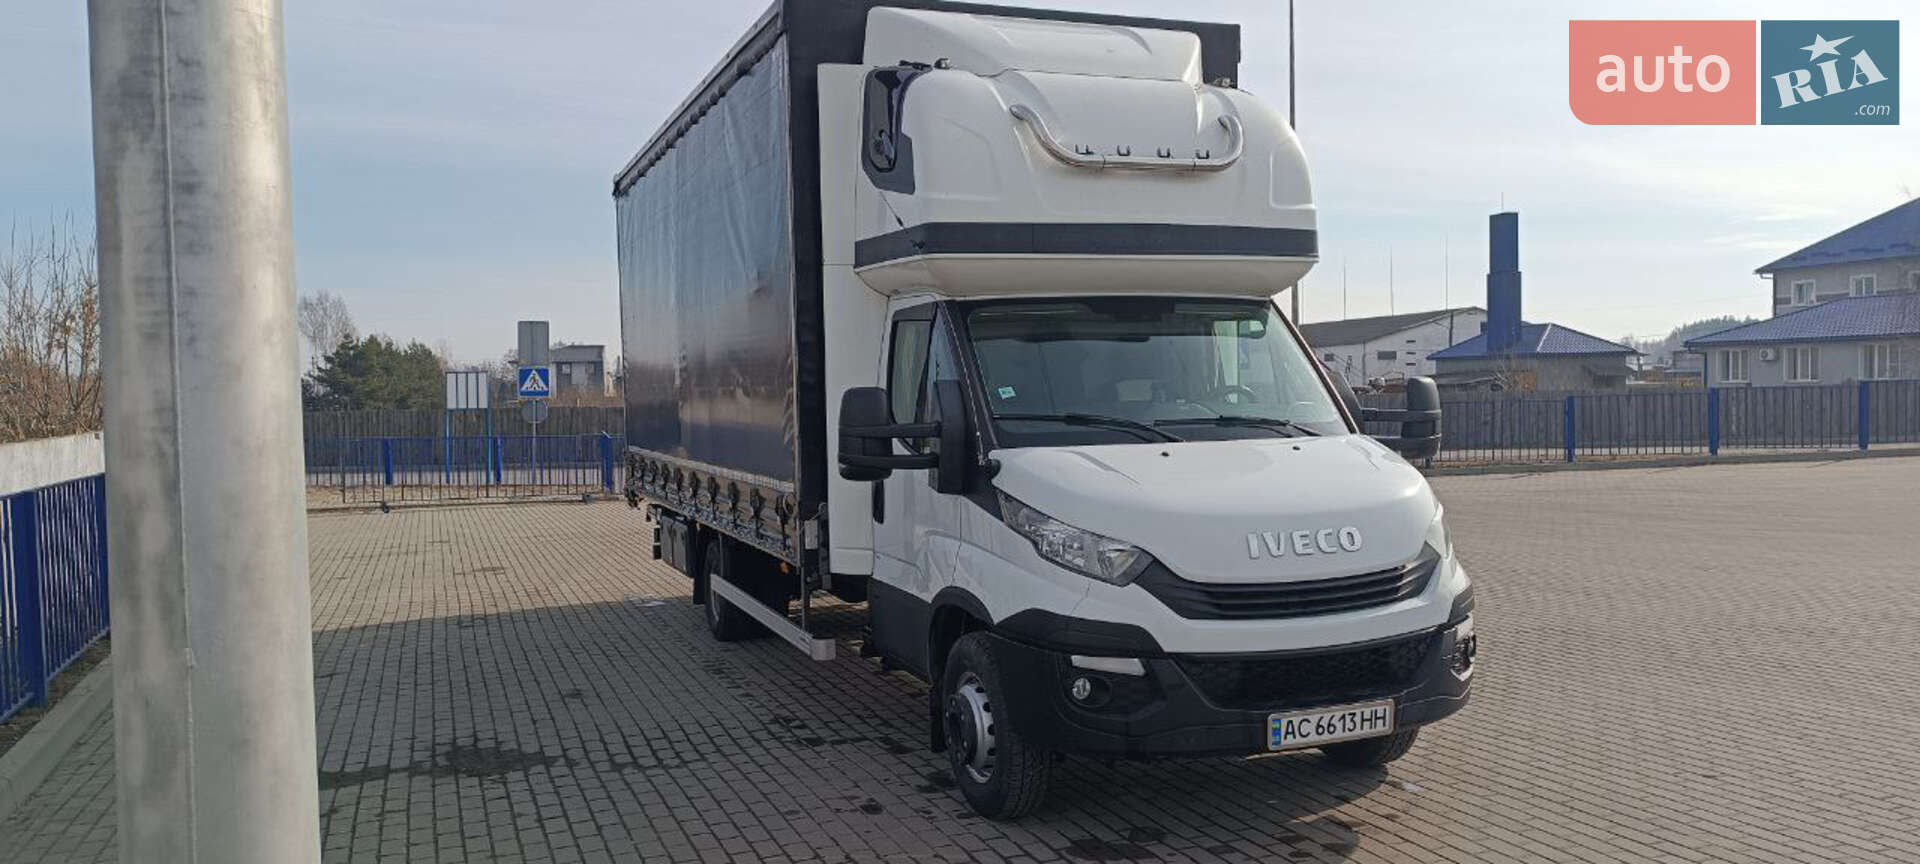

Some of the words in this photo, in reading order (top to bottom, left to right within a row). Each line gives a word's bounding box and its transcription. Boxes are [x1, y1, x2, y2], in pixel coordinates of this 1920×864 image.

[1246, 526, 1362, 559] IVECO
[1283, 718, 1311, 740] AC
[1315, 712, 1357, 736] 6613
[1360, 707, 1387, 731] HH
